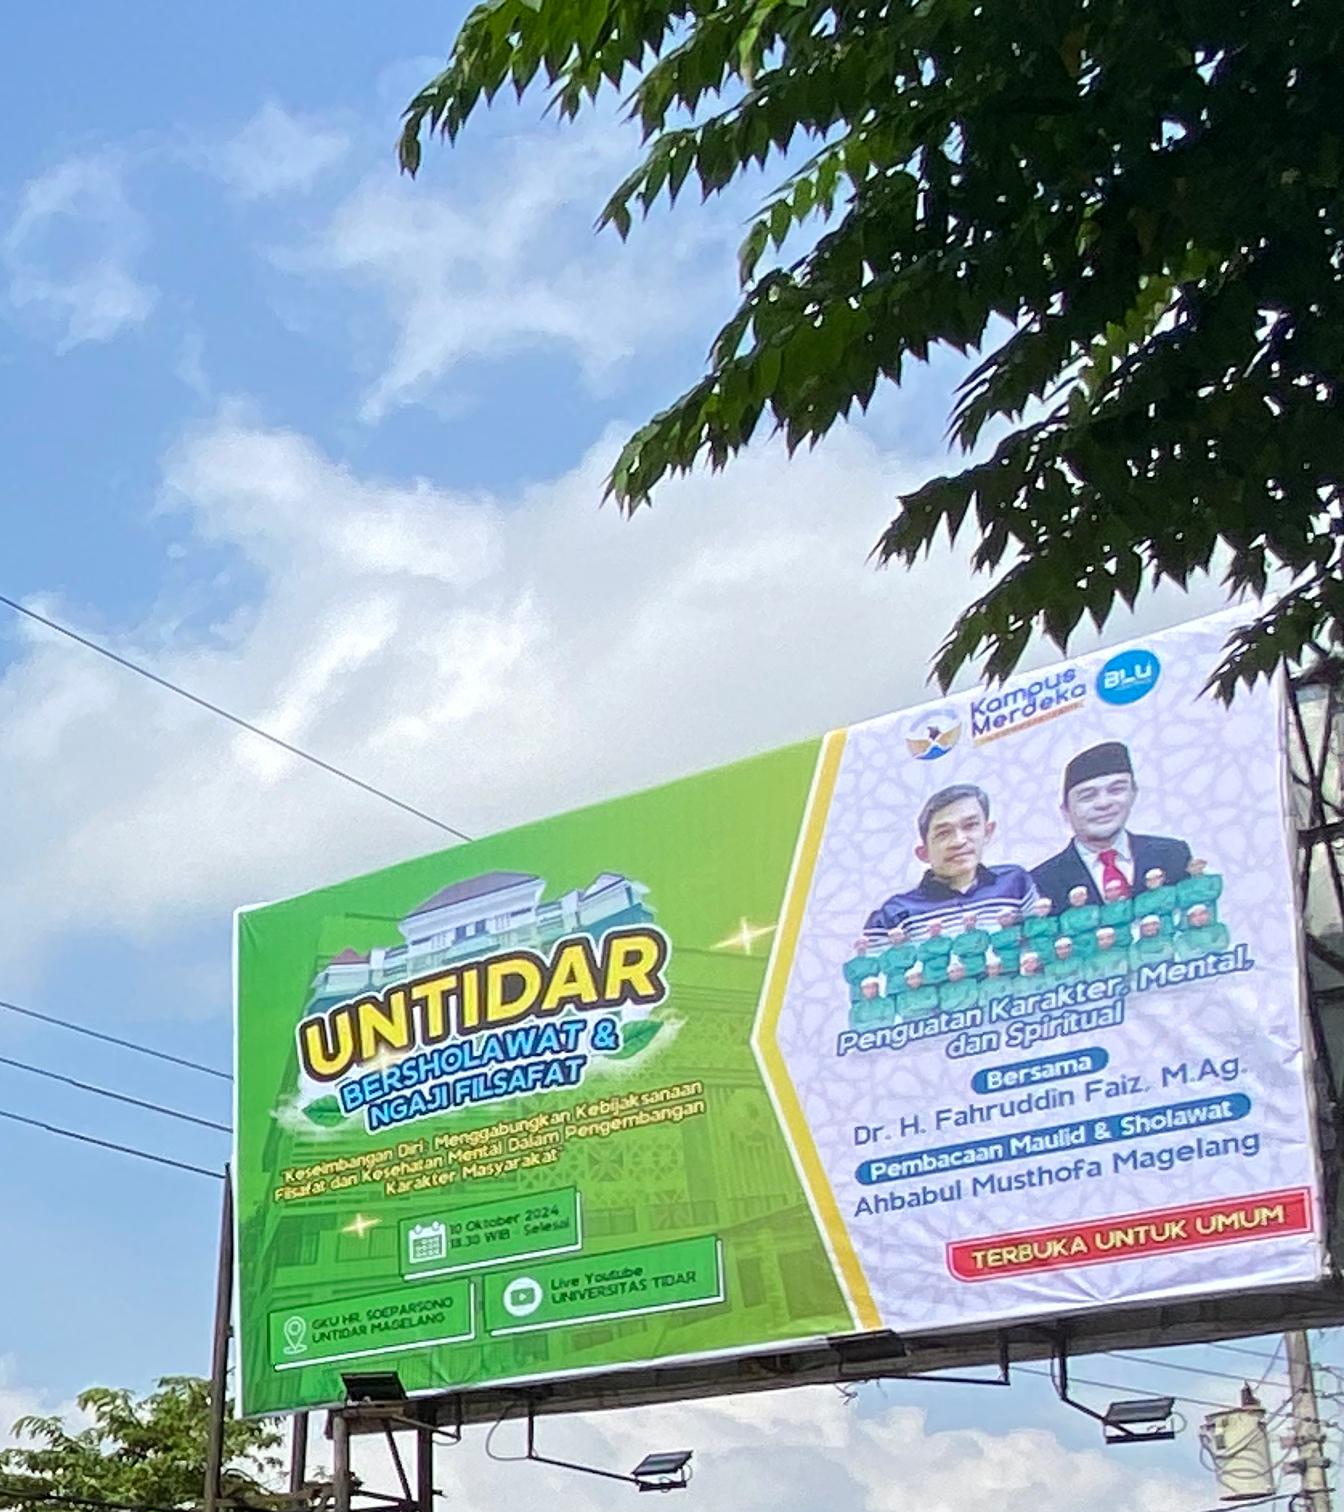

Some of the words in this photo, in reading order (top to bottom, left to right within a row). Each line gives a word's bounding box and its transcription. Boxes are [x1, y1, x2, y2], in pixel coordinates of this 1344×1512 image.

[970, 668, 1076, 717] Kampus
[1104, 660, 1152, 689] BLU
[971, 682, 1088, 738] Merdeka
[303, 931, 663, 1078] UNTIDAR
[836, 1006, 984, 1056] Penguatan
[1137, 943, 1254, 993] Mental,
[946, 1028, 1000, 1060] dan
[1005, 1001, 1125, 1048] Spiritual
[340, 1020, 585, 1112] BERSHOLAWAT
[592, 1018, 621, 1052] &
[986, 1054, 1094, 1091] Bersama
[368, 1085, 450, 1131] NGAJI
[453, 1059, 584, 1106] FILSAFAT
[434, 1109, 572, 1149] Menggabungkan
[574, 1079, 704, 1118] Kebijaksanaan
[853, 1123, 893, 1146] Dr.
[900, 1115, 928, 1139] H.
[936, 1087, 1076, 1131] Fahruddin
[1162, 1057, 1249, 1088] M.Ag.
[275, 1181, 328, 1202] Filsafat
[330, 1171, 360, 1191] dan
[362, 1155, 444, 1182] Kesehatan
[448, 1141, 503, 1166] Mental
[507, 1129, 561, 1153] Dalam
[564, 1098, 706, 1141] Pengembangan
[869, 1142, 1004, 1182] Pembacaan
[1011, 1124, 1087, 1157] Maulid
[1093, 1119, 1113, 1141] &
[1120, 1098, 1234, 1137] Sholawat
[385, 1167, 457, 1197] Karakter
[853, 1180, 962, 1217] Ahbabul
[972, 1158, 1103, 1198] Musthofa
[1112, 1133, 1261, 1175] Magelang
[449, 1223, 464, 1236] 10
[465, 1212, 521, 1232] Oktober
[524, 1204, 560, 1222] 2024
[484, 1228, 511, 1244] WIB
[971, 1237, 1089, 1270] TERBUKA
[1094, 1220, 1187, 1252] UNTUK
[1195, 1204, 1285, 1235] UMUM
[550, 1277, 581, 1291] Live
[584, 1266, 644, 1284] Youtube
[551, 1279, 648, 1305] UNIVERSITAS
[652, 1271, 697, 1289] TIDAR
[312, 1325, 368, 1344] UNTIDAR
[370, 1311, 446, 1335] MAGELANG
